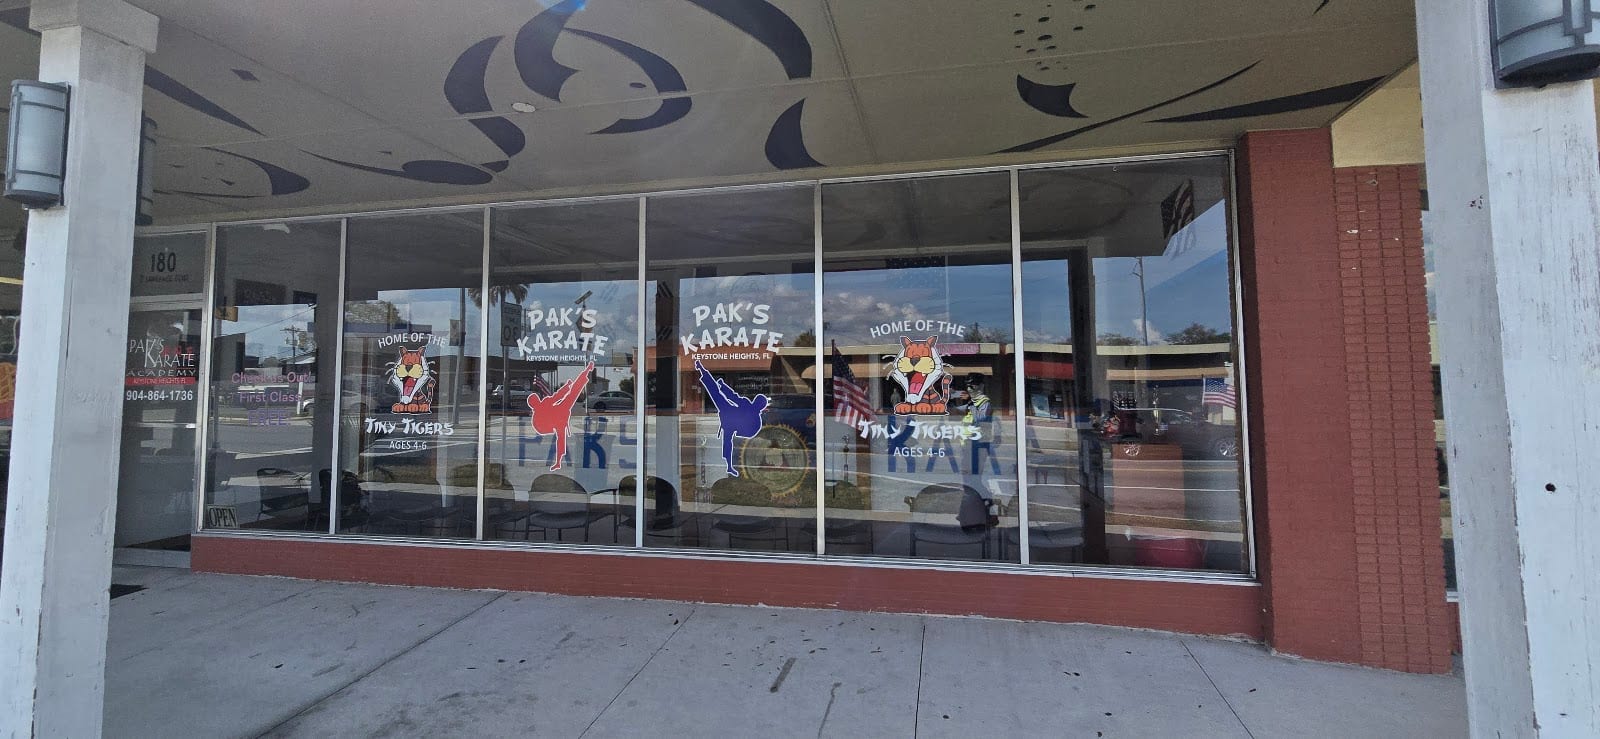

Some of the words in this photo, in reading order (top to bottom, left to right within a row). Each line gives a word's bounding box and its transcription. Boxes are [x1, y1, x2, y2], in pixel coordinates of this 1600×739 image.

[151, 252, 176, 272] 180
[527, 307, 598, 330] PAK'S
[692, 302, 771, 327] PAK'S
[870, 320, 911, 338] HOME
[915, 319, 933, 331] OF
[937, 320, 966, 337] THE
[378, 333, 408, 348] HOME
[410, 332, 425, 343] OF
[427, 333, 446, 347] THE
[516, 330, 609, 357] KARATE
[680, 326, 784, 356] KARATE
[144, 338, 195, 368] KARATE
[127, 369, 196, 377] ACADEMY
[126, 389, 194, 401] 904-864-1736
[239, 392, 267, 403] First
[269, 391, 301, 402] Class
[364, 417, 397, 434] TINY
[401, 417, 455, 435] TIGERS
[858, 419, 902, 439] TINY
[905, 419, 982, 441] TIGERS
[389, 440, 410, 450] AGES
[413, 441, 428, 450] 4-6
[893, 446, 923, 457] AGES
[926, 447, 946, 457] 4-6
[209, 507, 238, 527] OPEN
